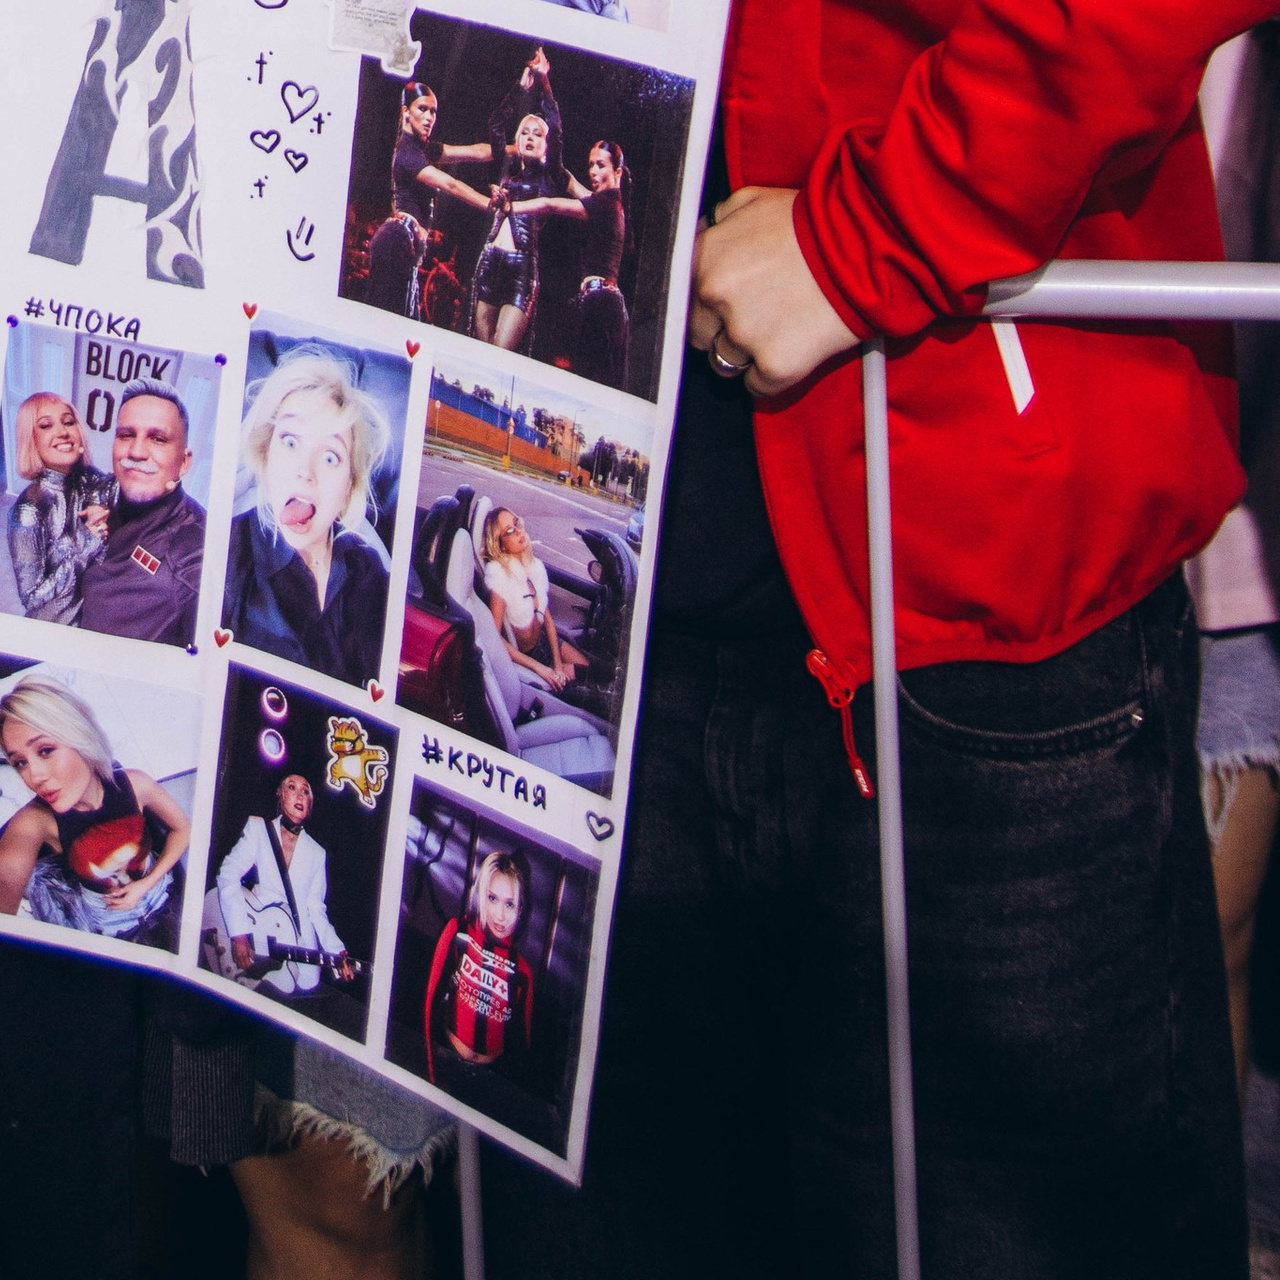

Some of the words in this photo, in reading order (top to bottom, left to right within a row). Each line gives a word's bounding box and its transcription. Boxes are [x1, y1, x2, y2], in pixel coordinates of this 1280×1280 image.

[24, 296, 142, 342] #ЧПОКА
[85, 340, 172, 383] BLOCK
[421, 733, 547, 811] #КРУТАЯ
